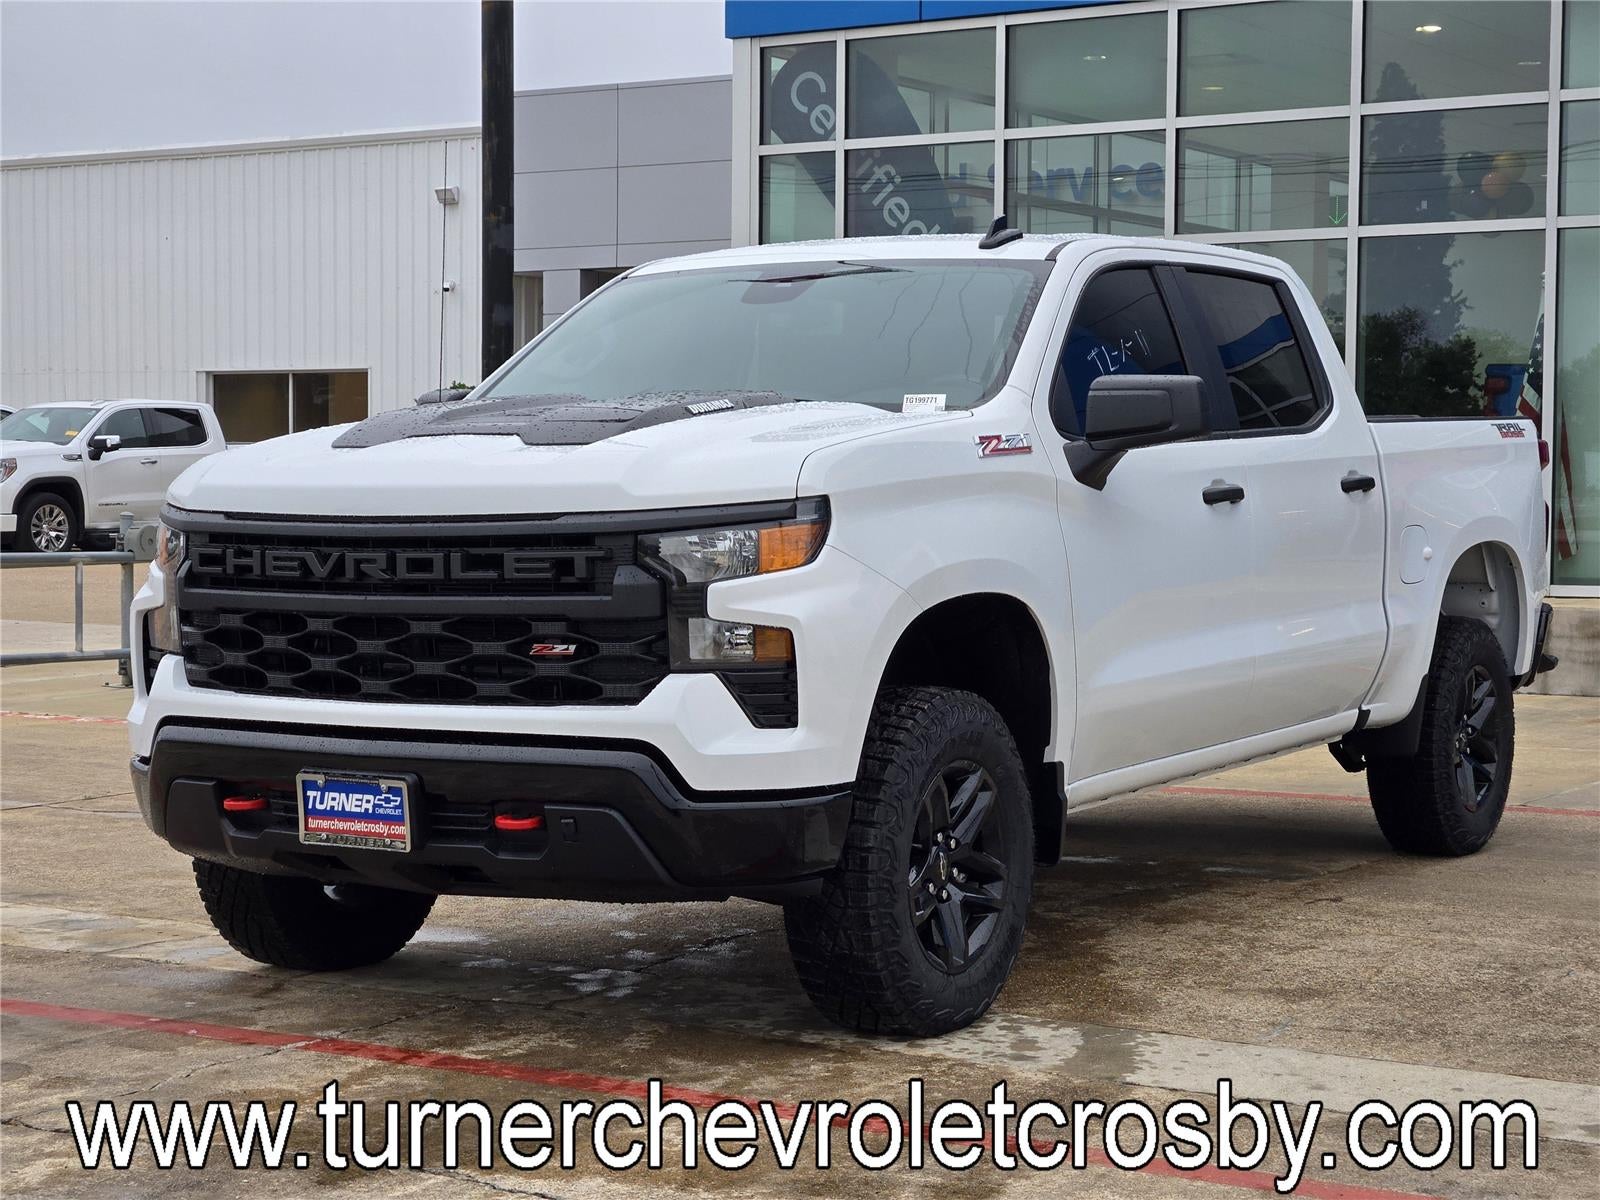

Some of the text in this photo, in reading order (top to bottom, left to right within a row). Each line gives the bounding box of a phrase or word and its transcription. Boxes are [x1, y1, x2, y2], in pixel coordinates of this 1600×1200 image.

[790, 71, 941, 235] Ceified
[687, 398, 735, 415] DURAMAX
[1490, 422, 1526, 432] TRAIL
[974, 433, 1033, 459] Z71
[191, 546, 612, 581] CHEVROLET
[529, 643, 577, 657] Z71
[306, 790, 375, 814] TURNER
[375, 808, 402, 816] CHEVROLET
[308, 817, 407, 836] turnerchevroletcrosby.com
